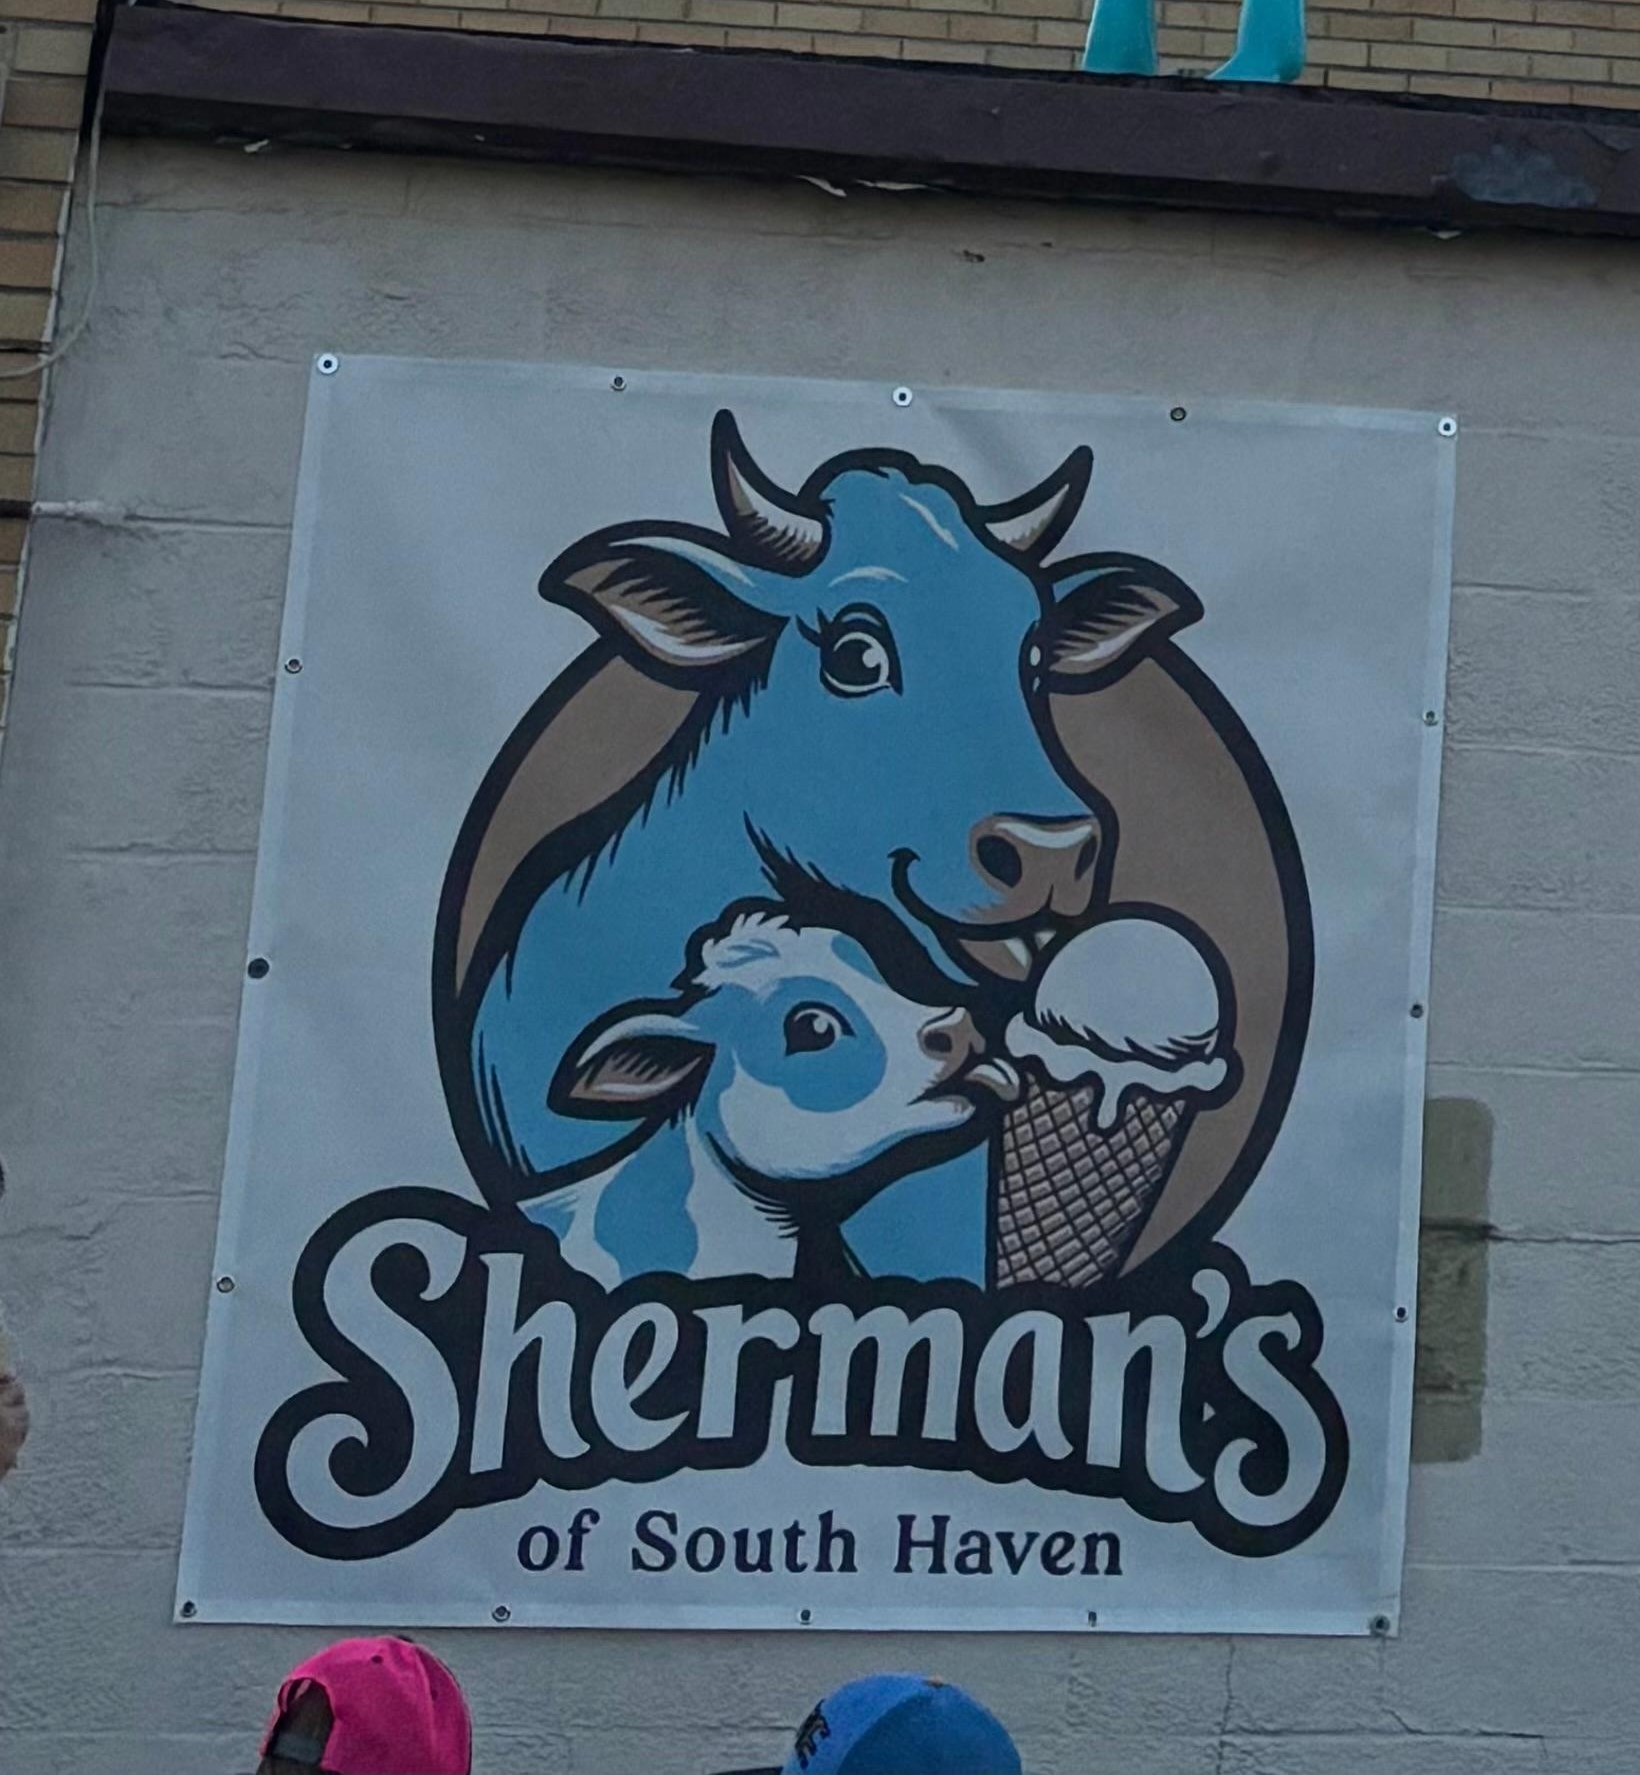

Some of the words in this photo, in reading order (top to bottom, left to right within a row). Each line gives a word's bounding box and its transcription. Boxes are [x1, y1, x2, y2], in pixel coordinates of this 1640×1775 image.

[285, 1217, 1327, 1530] Sherman's
[515, 1507, 602, 1573] of
[630, 1508, 859, 1575] South
[892, 1512, 1124, 1577] Haven
